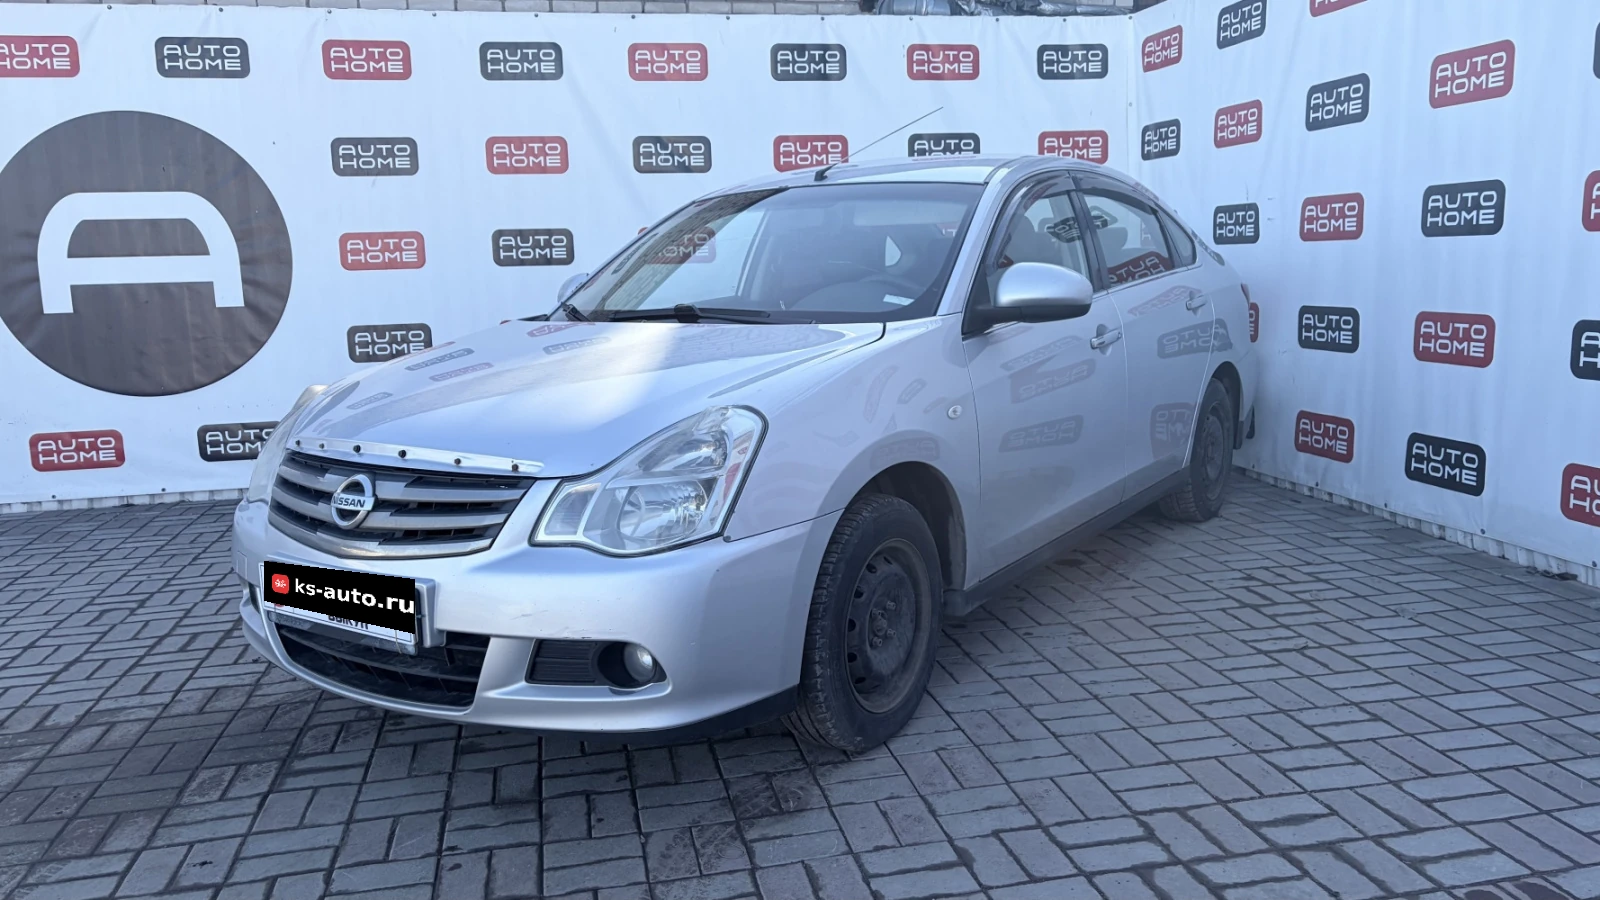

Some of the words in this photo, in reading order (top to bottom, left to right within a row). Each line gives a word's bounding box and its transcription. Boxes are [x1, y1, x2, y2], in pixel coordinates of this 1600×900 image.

[1221, 2, 1262, 27] AUTO
[1220, 16, 1261, 41] HOME
[1145, 33, 1179, 53] AUTO
[164, 44, 240, 57] AUTO
[330, 47, 403, 60] AUTO
[487, 49, 556, 60] AUTO
[635, 50, 701, 61] AUTO
[777, 50, 840, 62] AUTO
[913, 50, 973, 62] AUTO
[1043, 50, 1102, 61] AUTO
[1144, 45, 1178, 65] HOME
[164, 58, 241, 70] HOME
[331, 60, 404, 72] HOME
[487, 62, 556, 73] HOME
[635, 62, 701, 74] HOME
[777, 63, 840, 74] HOME
[913, 63, 973, 74] HOME
[1043, 62, 1102, 73] HOME
[1436, 51, 1506, 80] AUTO
[1435, 70, 1505, 98] HOME
[1310, 83, 1363, 107] AUTO
[1310, 99, 1362, 122] HOME
[1218, 108, 1258, 127] AUTO
[1145, 126, 1177, 141] AUTO
[1217, 122, 1257, 140] HOME
[493, 143, 561, 154] AUTO
[640, 143, 705, 154] AUTO
[780, 142, 842, 153] AUTO
[914, 140, 974, 151] AUTO
[1044, 137, 1102, 148] AUTO
[1144, 138, 1176, 154] HOME
[339, 145, 410, 156] AUTO
[340, 157, 411, 169] HOME
[494, 156, 561, 167] HOME
[640, 155, 704, 166] HOME
[780, 154, 841, 165] HOME
[1428, 191, 1497, 210] AUTO
[1305, 202, 1358, 218] AUTO
[1216, 211, 1255, 224] AUTO
[1427, 209, 1495, 227] HOME
[1216, 224, 1254, 237] HOME
[1304, 217, 1357, 232] HOME
[347, 238, 417, 251] AUTO
[499, 236, 567, 247] AUTO
[347, 251, 418, 263] HOME
[500, 248, 567, 259] HOME
[1302, 314, 1353, 329] AUTO
[355, 330, 424, 343] AUTO
[1302, 328, 1352, 344] HOME
[1420, 321, 1487, 339] AUTO
[355, 343, 424, 356] HOME
[1419, 338, 1485, 357] HOME
[1300, 419, 1349, 439] AUTO
[38, 437, 115, 452] AUTO
[207, 442, 266, 454] HOM
[1299, 432, 1347, 454] HOME
[39, 450, 116, 464] HOME
[1412, 442, 1478, 468] AUTO
[1411, 458, 1477, 486] HOME
